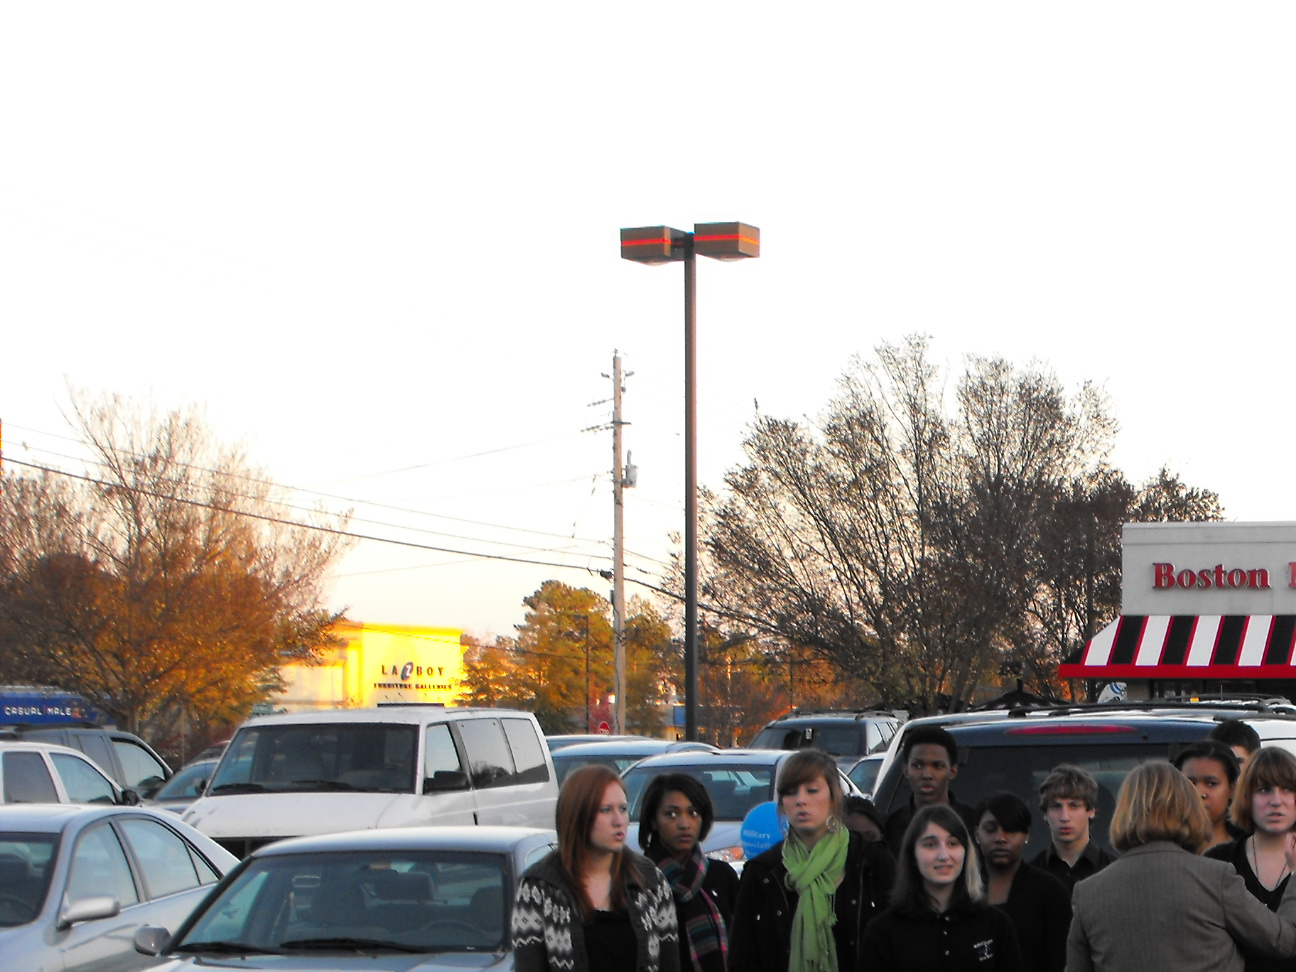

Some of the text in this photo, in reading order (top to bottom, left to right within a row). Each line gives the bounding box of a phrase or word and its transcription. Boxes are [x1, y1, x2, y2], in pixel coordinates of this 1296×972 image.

[1152, 562, 1271, 589] Boston
[5, 706, 42, 716] CASUAL
[47, 707, 72, 716] MALE
